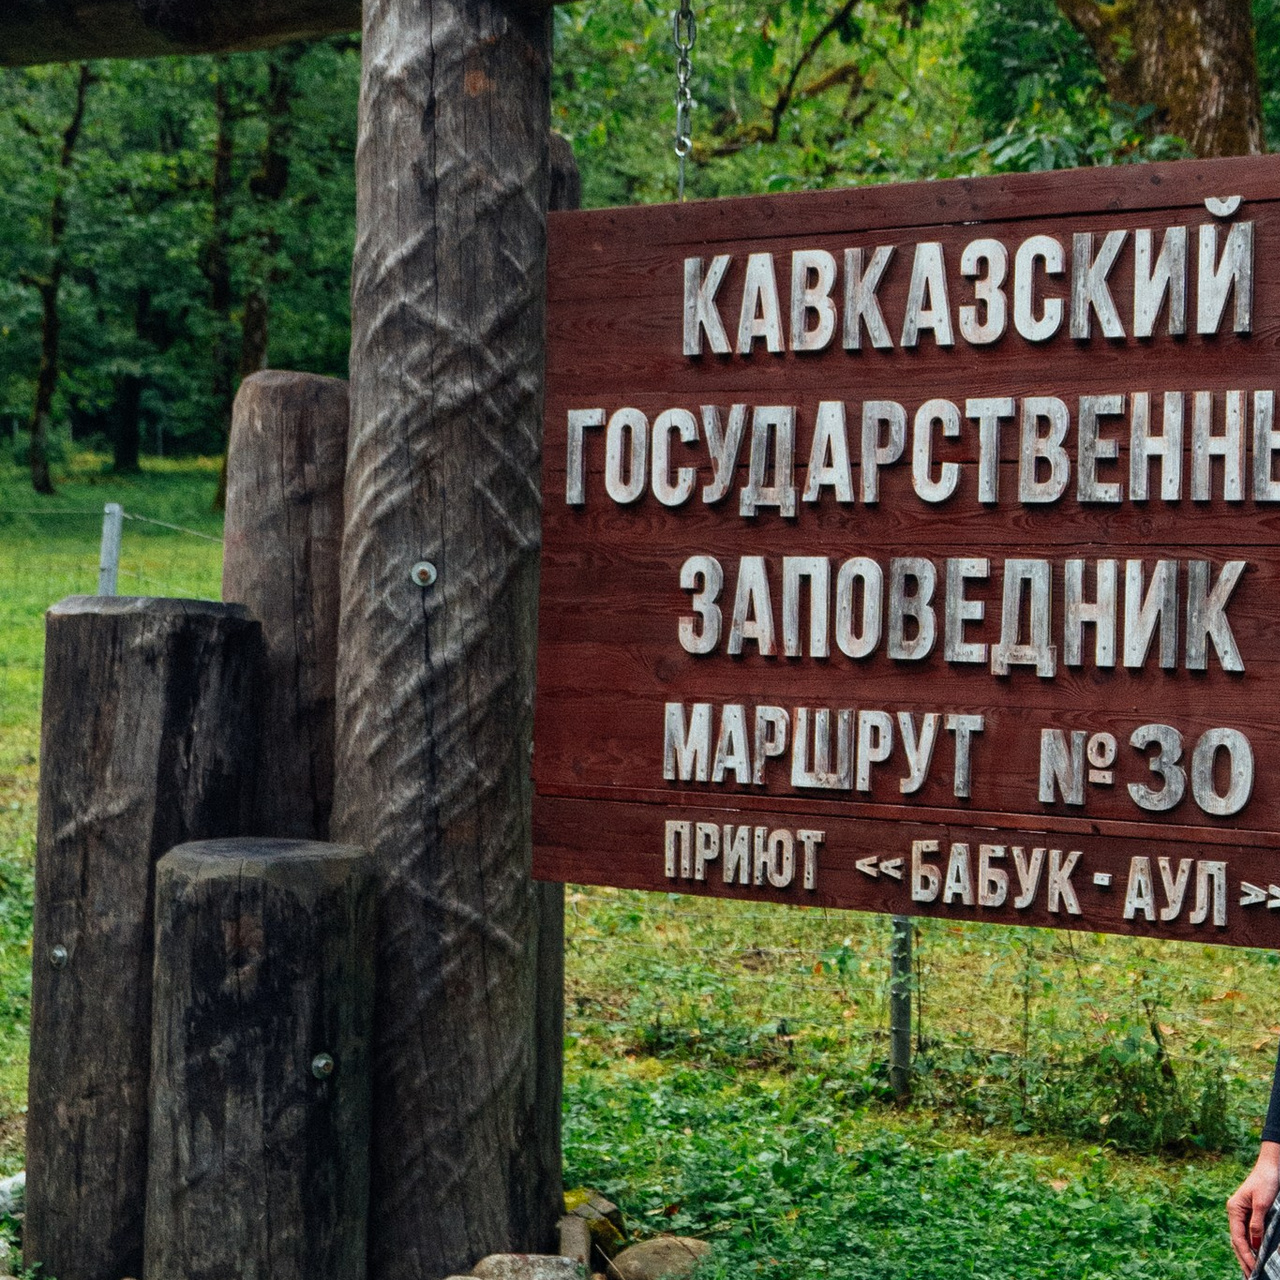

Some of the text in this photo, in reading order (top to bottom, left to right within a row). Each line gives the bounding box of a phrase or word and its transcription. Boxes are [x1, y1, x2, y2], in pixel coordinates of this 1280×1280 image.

[682, 195, 1255, 357] КАВКАЗСКИЙ
[677, 554, 1249, 679] ЗАПОВЕДНИК
[662, 702, 985, 799] МАРШРУТ
[663, 819, 826, 891] ПРИЮТ
